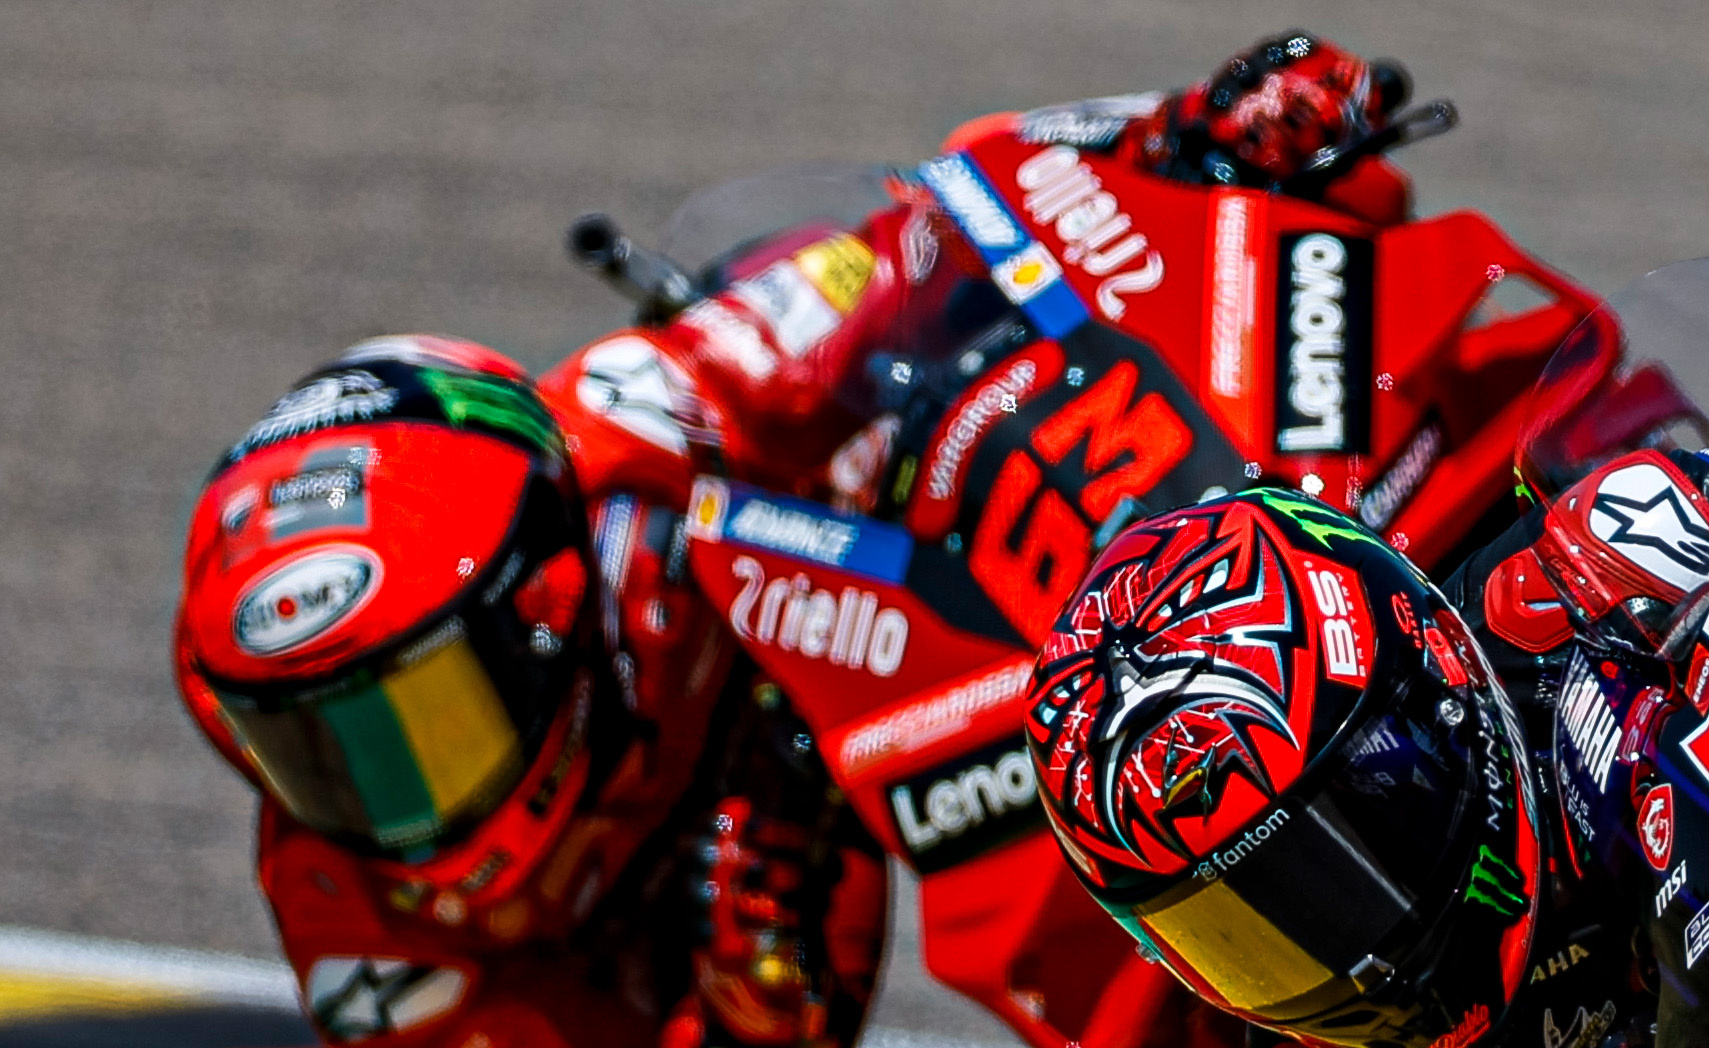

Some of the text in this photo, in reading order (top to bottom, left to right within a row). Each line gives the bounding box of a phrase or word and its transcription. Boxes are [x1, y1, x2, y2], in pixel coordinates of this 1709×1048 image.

[1279, 232, 1347, 451] Lenovo
[968, 360, 1193, 648] 63
[1308, 570, 1357, 676] BS
[892, 748, 1037, 852] Leno
[1212, 805, 1290, 871] fantom
[1655, 859, 1687, 918] msi
[1530, 943, 1590, 985] AHA
